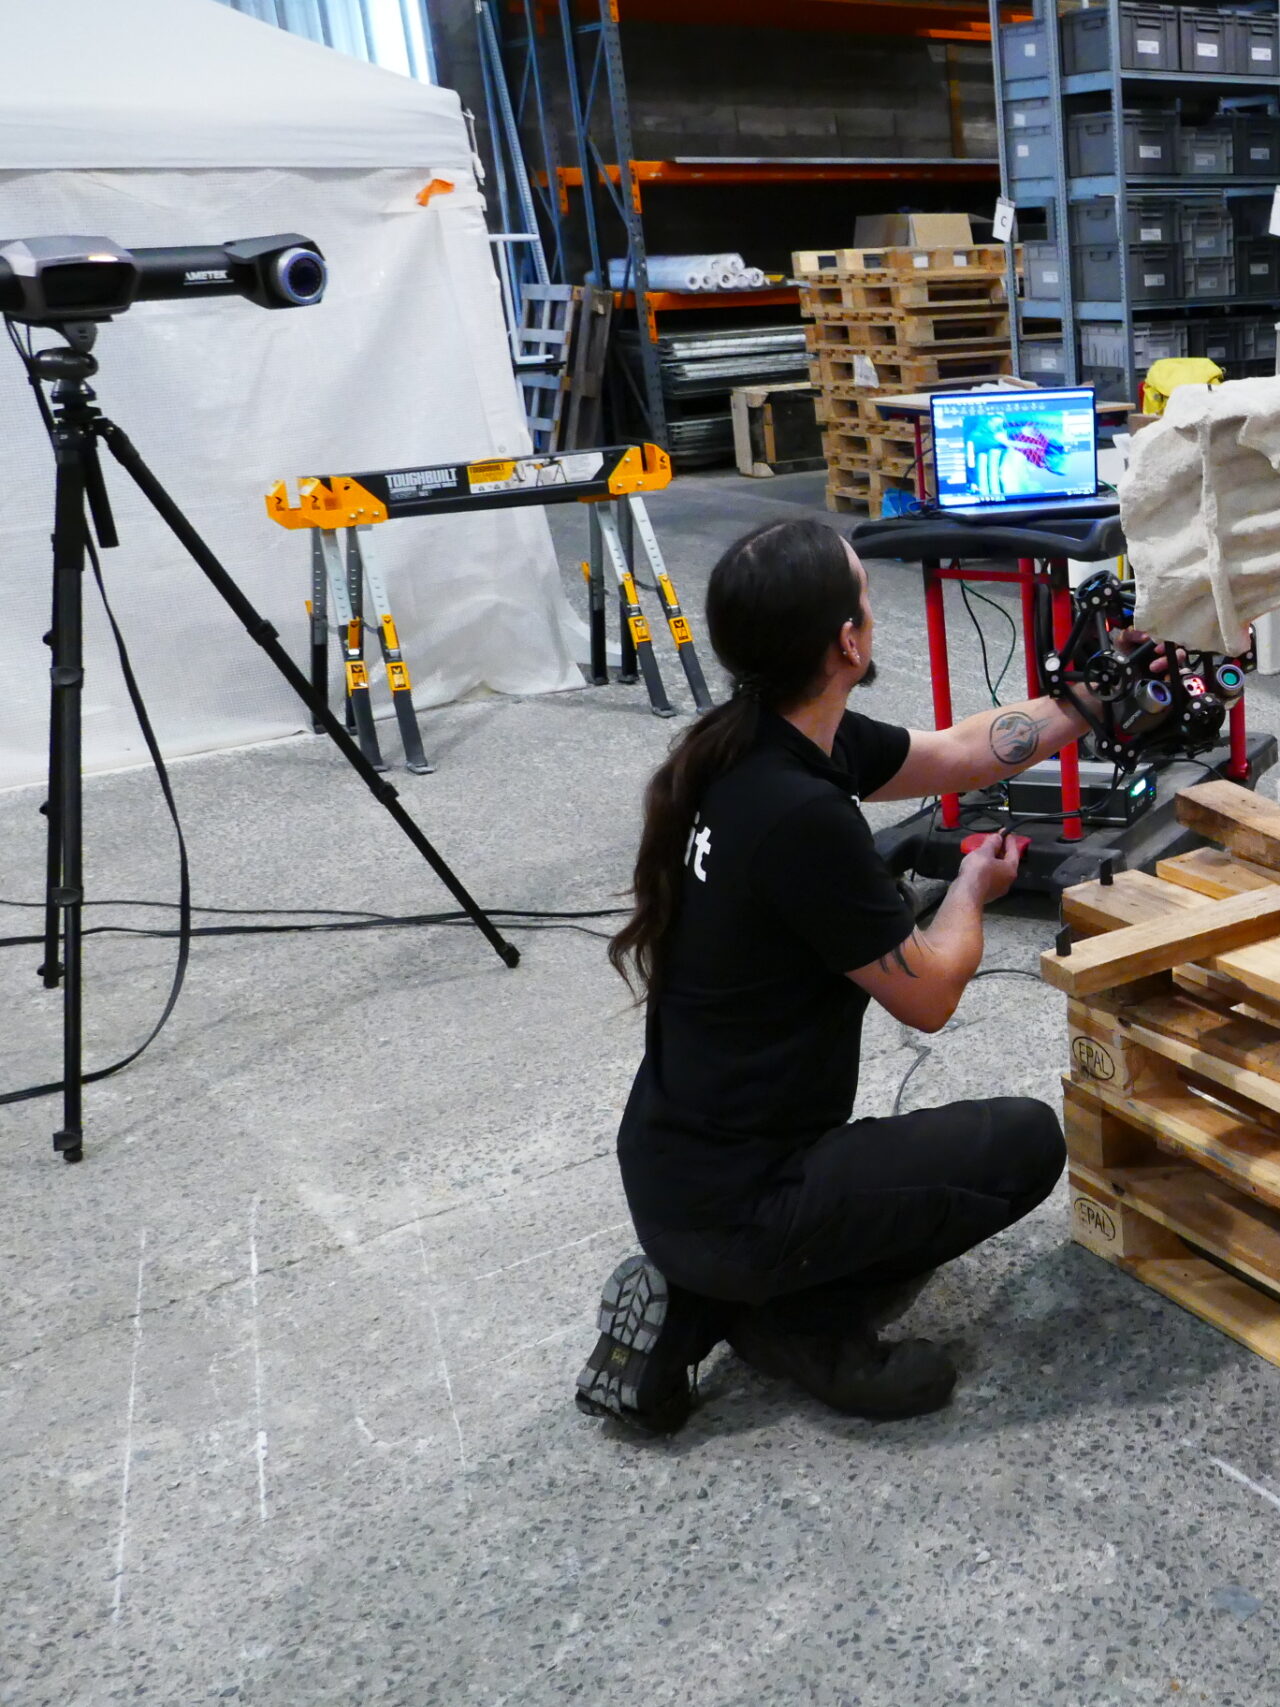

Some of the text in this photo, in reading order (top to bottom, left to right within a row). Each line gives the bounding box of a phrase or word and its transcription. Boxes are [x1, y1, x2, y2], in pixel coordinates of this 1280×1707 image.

[1001, 215, 1008, 228] C
[384, 467, 458, 489] TOUGHBUILT
[1078, 1041, 1110, 1077] EPAL
[1080, 1202, 1111, 1238] EPAL
